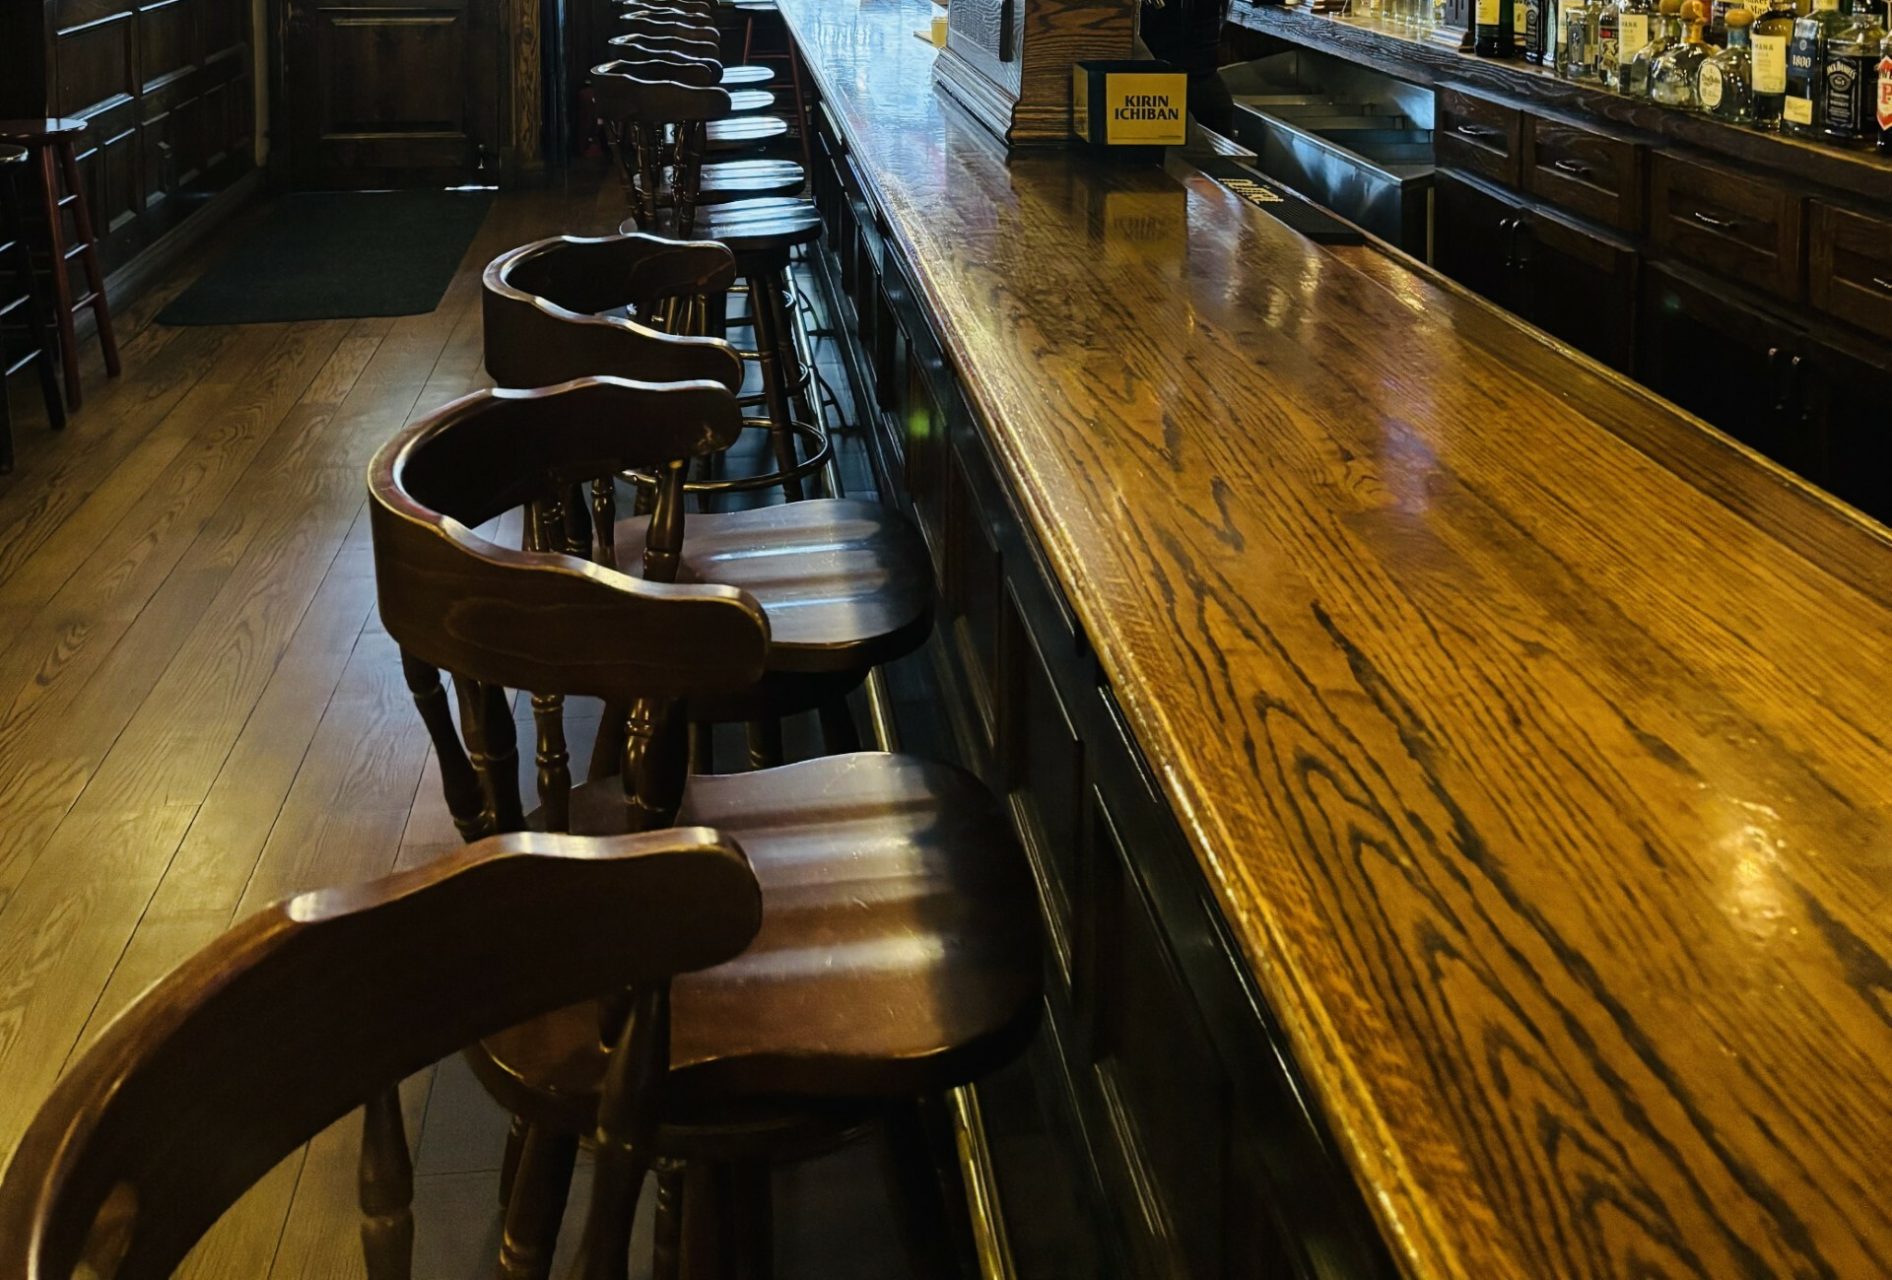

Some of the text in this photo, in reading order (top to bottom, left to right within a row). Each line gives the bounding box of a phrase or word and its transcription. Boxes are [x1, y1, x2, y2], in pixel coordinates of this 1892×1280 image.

[1792, 54, 1812, 68] 1800
[1125, 95, 1169, 107] KIRIN
[1114, 107, 1179, 120] ICHIBAN
